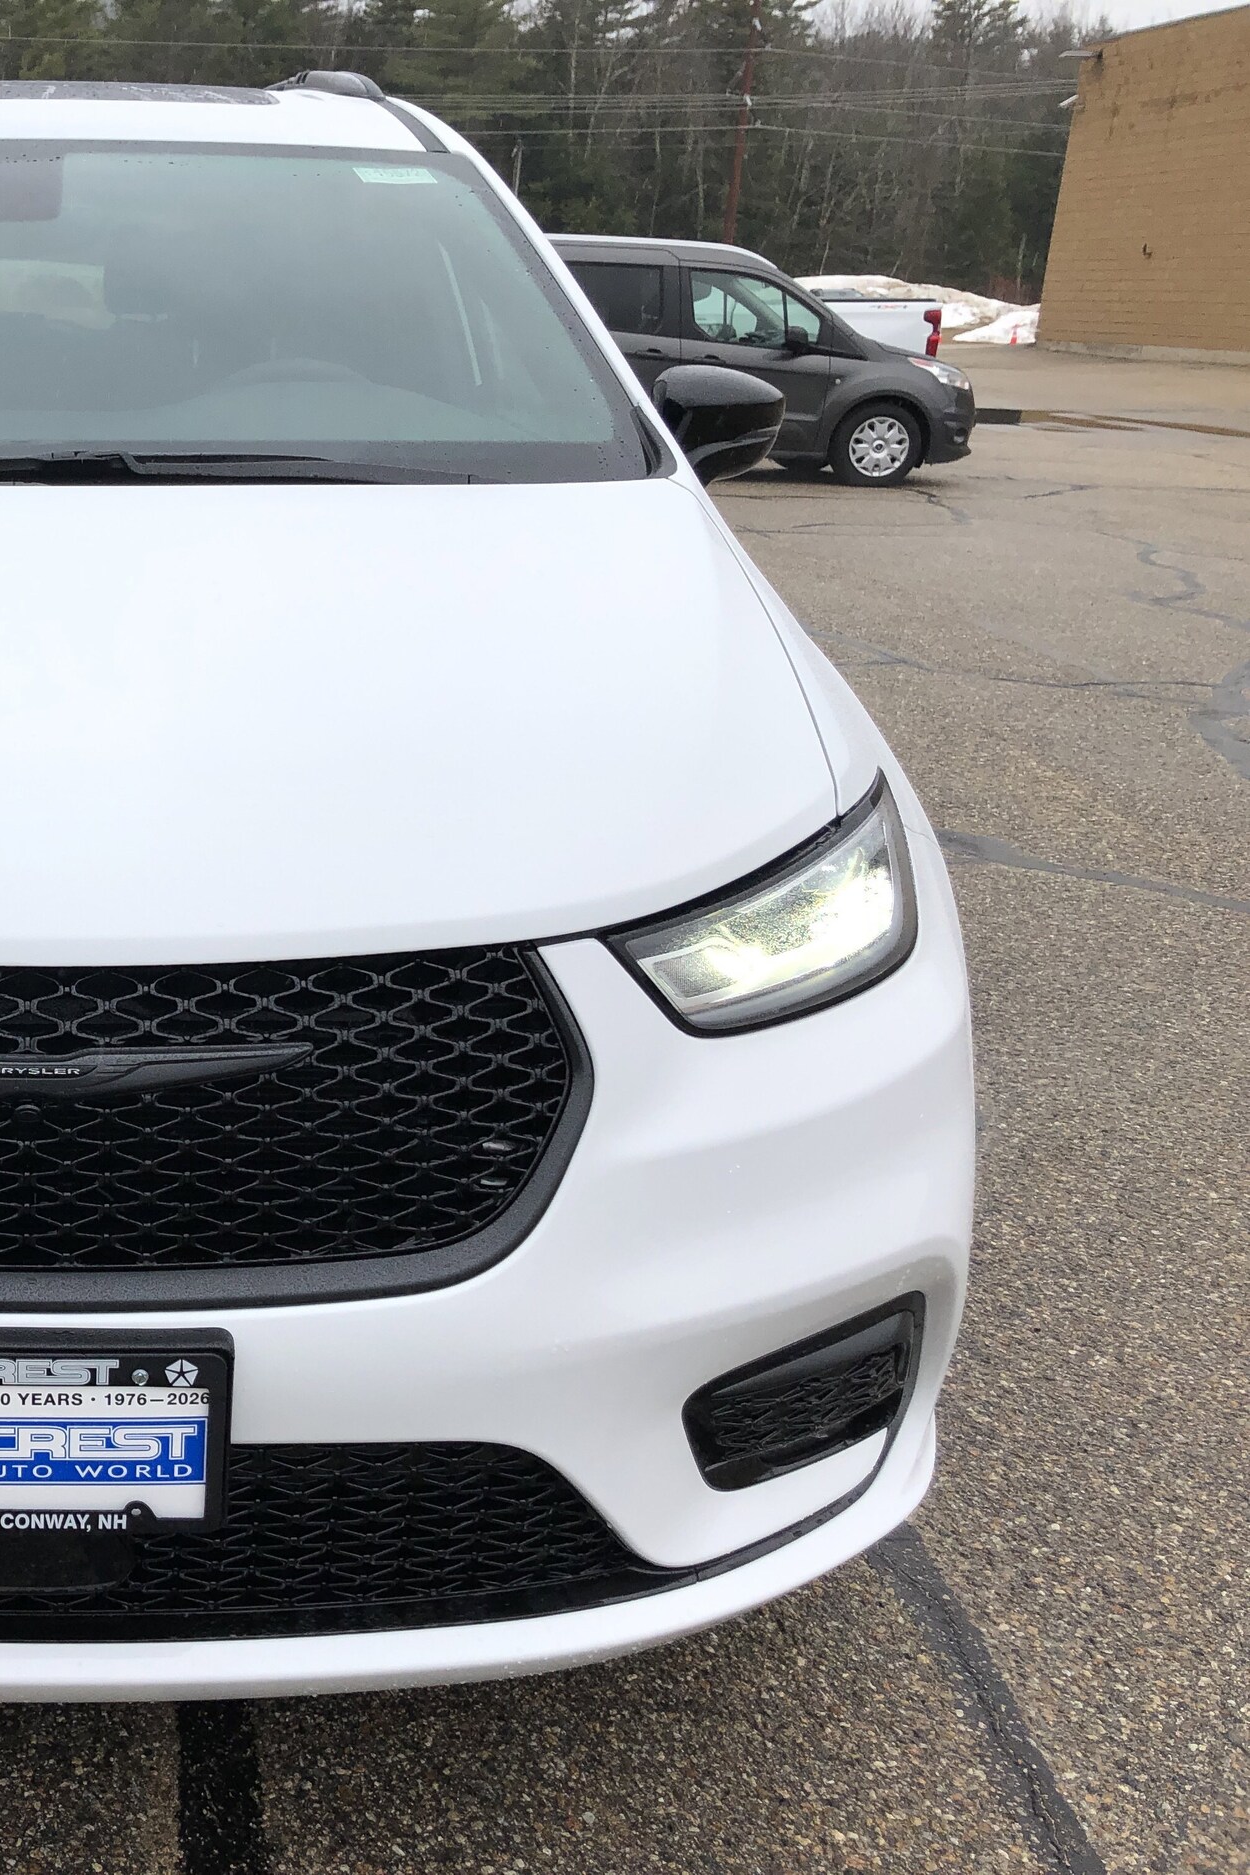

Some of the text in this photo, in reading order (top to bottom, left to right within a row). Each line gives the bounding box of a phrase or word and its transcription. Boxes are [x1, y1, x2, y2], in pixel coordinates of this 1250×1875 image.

[18, 1393, 83, 1406] YEARS
[75, 1464, 192, 1478] WORLD
[0, 1513, 91, 1532] CONWAY,
[98, 1514, 127, 1529] NH
